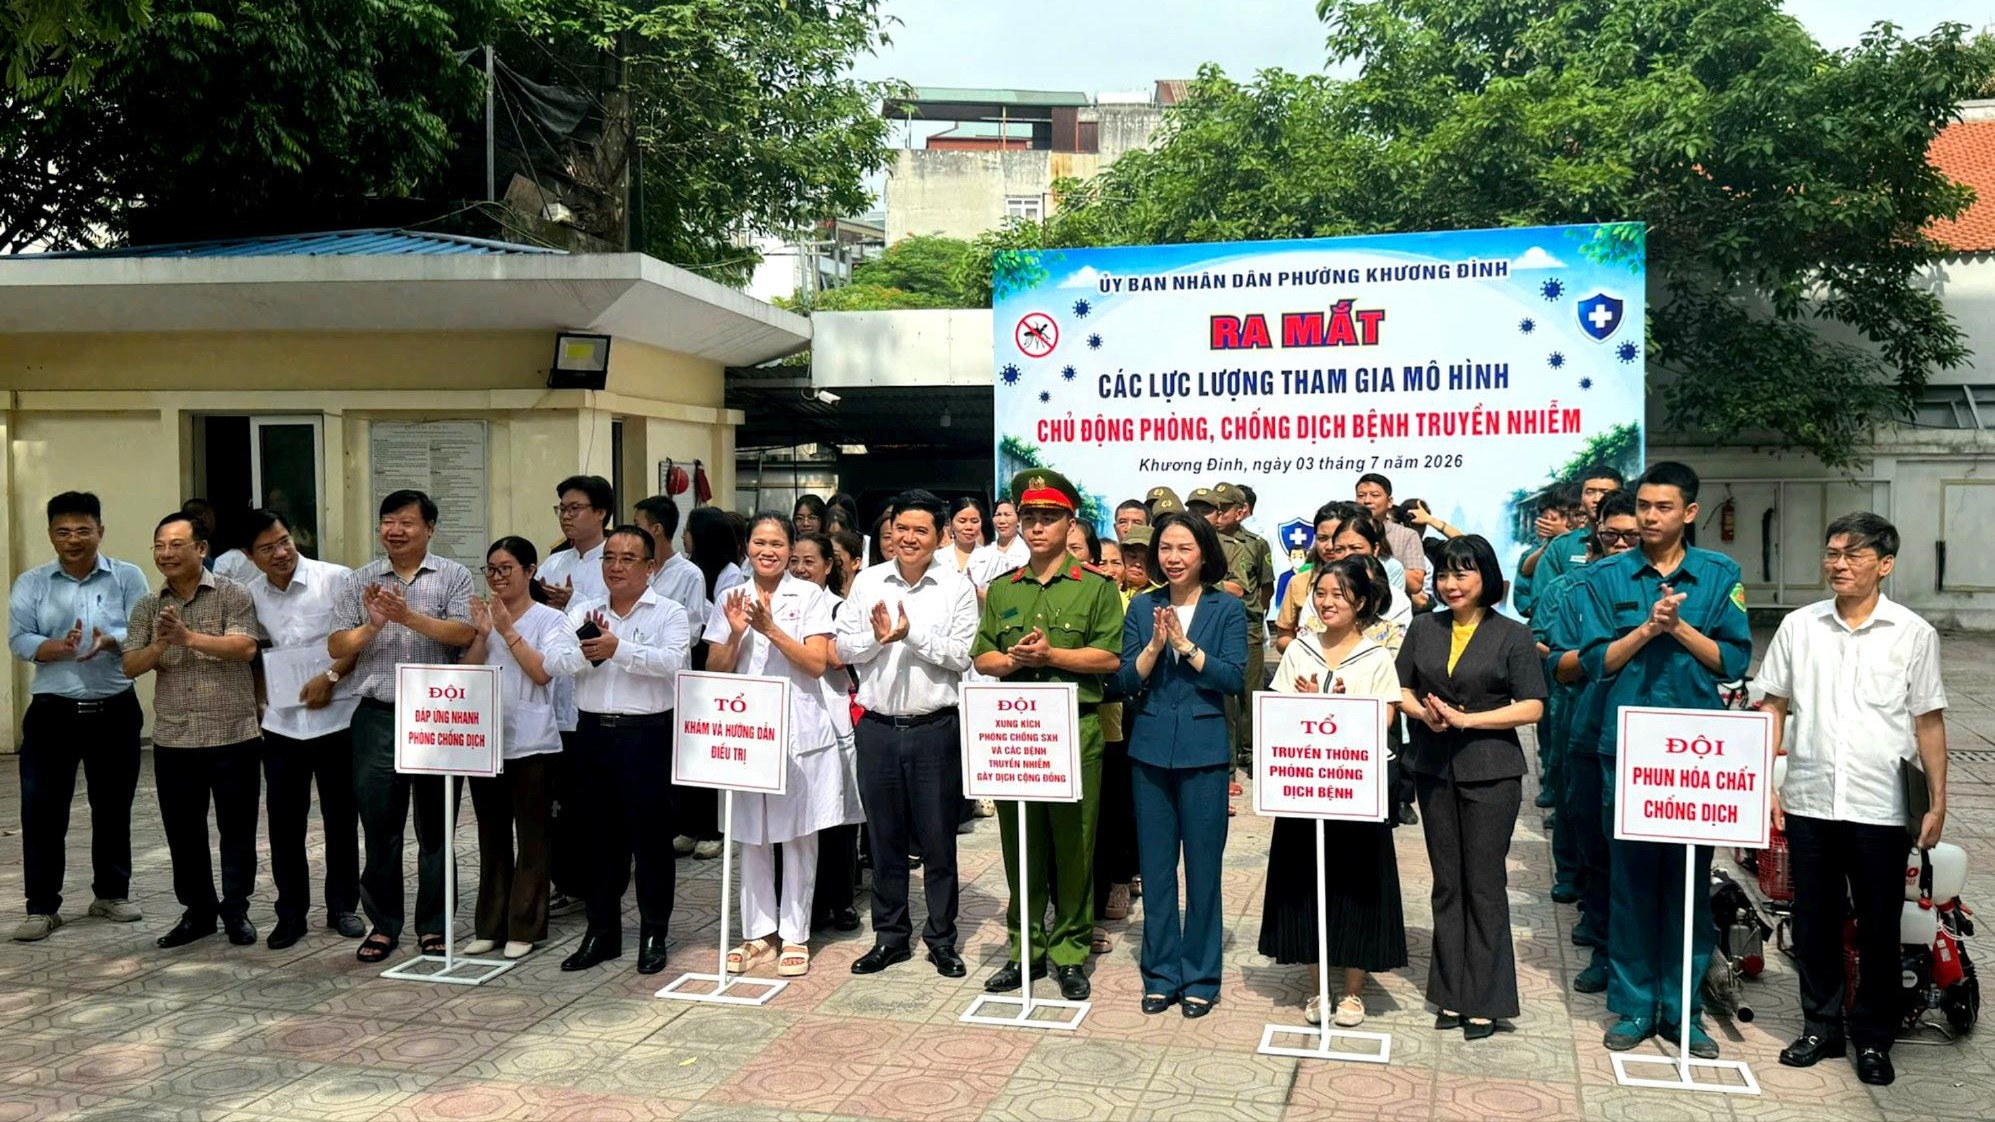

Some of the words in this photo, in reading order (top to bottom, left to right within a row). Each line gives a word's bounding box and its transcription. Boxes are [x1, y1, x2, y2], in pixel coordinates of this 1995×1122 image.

[1099, 273, 1122, 293] ỦY
[1128, 276, 1167, 292] BAN
[1173, 271, 1226, 291] NHÂN
[1232, 269, 1272, 288] DÂN
[1278, 265, 1360, 287] PHƯỜNG
[1366, 264, 1450, 283] KHƯƠNG
[1457, 259, 1508, 279] ĐÌNH
[1210, 314, 1273, 350] RA
[1281, 298, 1386, 349] MẮT
[1099, 368, 1142, 399] CÁC
[1149, 370, 1191, 403] LỰC
[1199, 368, 1274, 402] LƯỢNG
[1281, 368, 1347, 395] THAM
[1355, 366, 1395, 393] GIA
[1403, 360, 1440, 392] MÔ
[1449, 358, 1509, 391] HÌNH
[1037, 411, 1075, 443] CHỦ
[1081, 413, 1134, 447] ĐỘNG
[1140, 412, 1215, 444] PHÒNG,
[1221, 407, 1290, 440] CHỐNG
[1297, 414, 1346, 444] DỊCH
[1353, 408, 1409, 444] BỆNH
[1416, 403, 1500, 437] TRUYỀN
[1507, 399, 1581, 435] NHIỄM
[1139, 458, 1202, 474] Khương
[1252, 457, 1292, 474] ngày
[1296, 457, 1315, 471] 03
[1319, 456, 1366, 473] tháng
[1371, 456, 1380, 470] 7
[1383, 455, 1419, 470] năm
[1424, 454, 1463, 469] 2026
[428, 684, 466, 702] ĐỘI
[714, 693, 747, 713] TỔ
[997, 697, 1037, 714] ĐỘI
[415, 707, 431, 722] ĐÁP
[433, 708, 450, 724] ỨNG
[451, 711, 479, 725] NHANH
[995, 719, 1019, 729] XUNG
[1020, 718, 1041, 729] KÍCH
[1300, 713, 1338, 735] TỔ
[408, 729, 436, 745] PHÒNG
[437, 728, 464, 746] CHỐNG
[466, 734, 486, 750] DỊCH
[684, 719, 710, 735] KHÁM
[711, 720, 723, 737] VÀ
[725, 722, 755, 740] HƯỚNG
[1009, 731, 1039, 743] CHỐNG
[1041, 733, 1059, 743] SXH
[733, 747, 747, 765] TRỊ
[1023, 746, 1047, 756] BỆNH
[1325, 747, 1369, 761] THÔNG
[1665, 734, 1725, 760] ĐỘI
[995, 772, 1015, 783] DỊCH
[1017, 772, 1041, 784] CỘNG
[1269, 763, 1314, 778] PHÒNG
[1318, 764, 1363, 781] CHỐNG
[1632, 767, 1675, 787] PHUN
[1680, 766, 1711, 789] HÓA
[1716, 765, 1756, 791] CHẤT
[1283, 785, 1314, 799] DỊCH
[1318, 785, 1353, 801] BỆNH
[1644, 794, 1696, 821] CHỐNG
[1701, 803, 1738, 827] DỊCH
